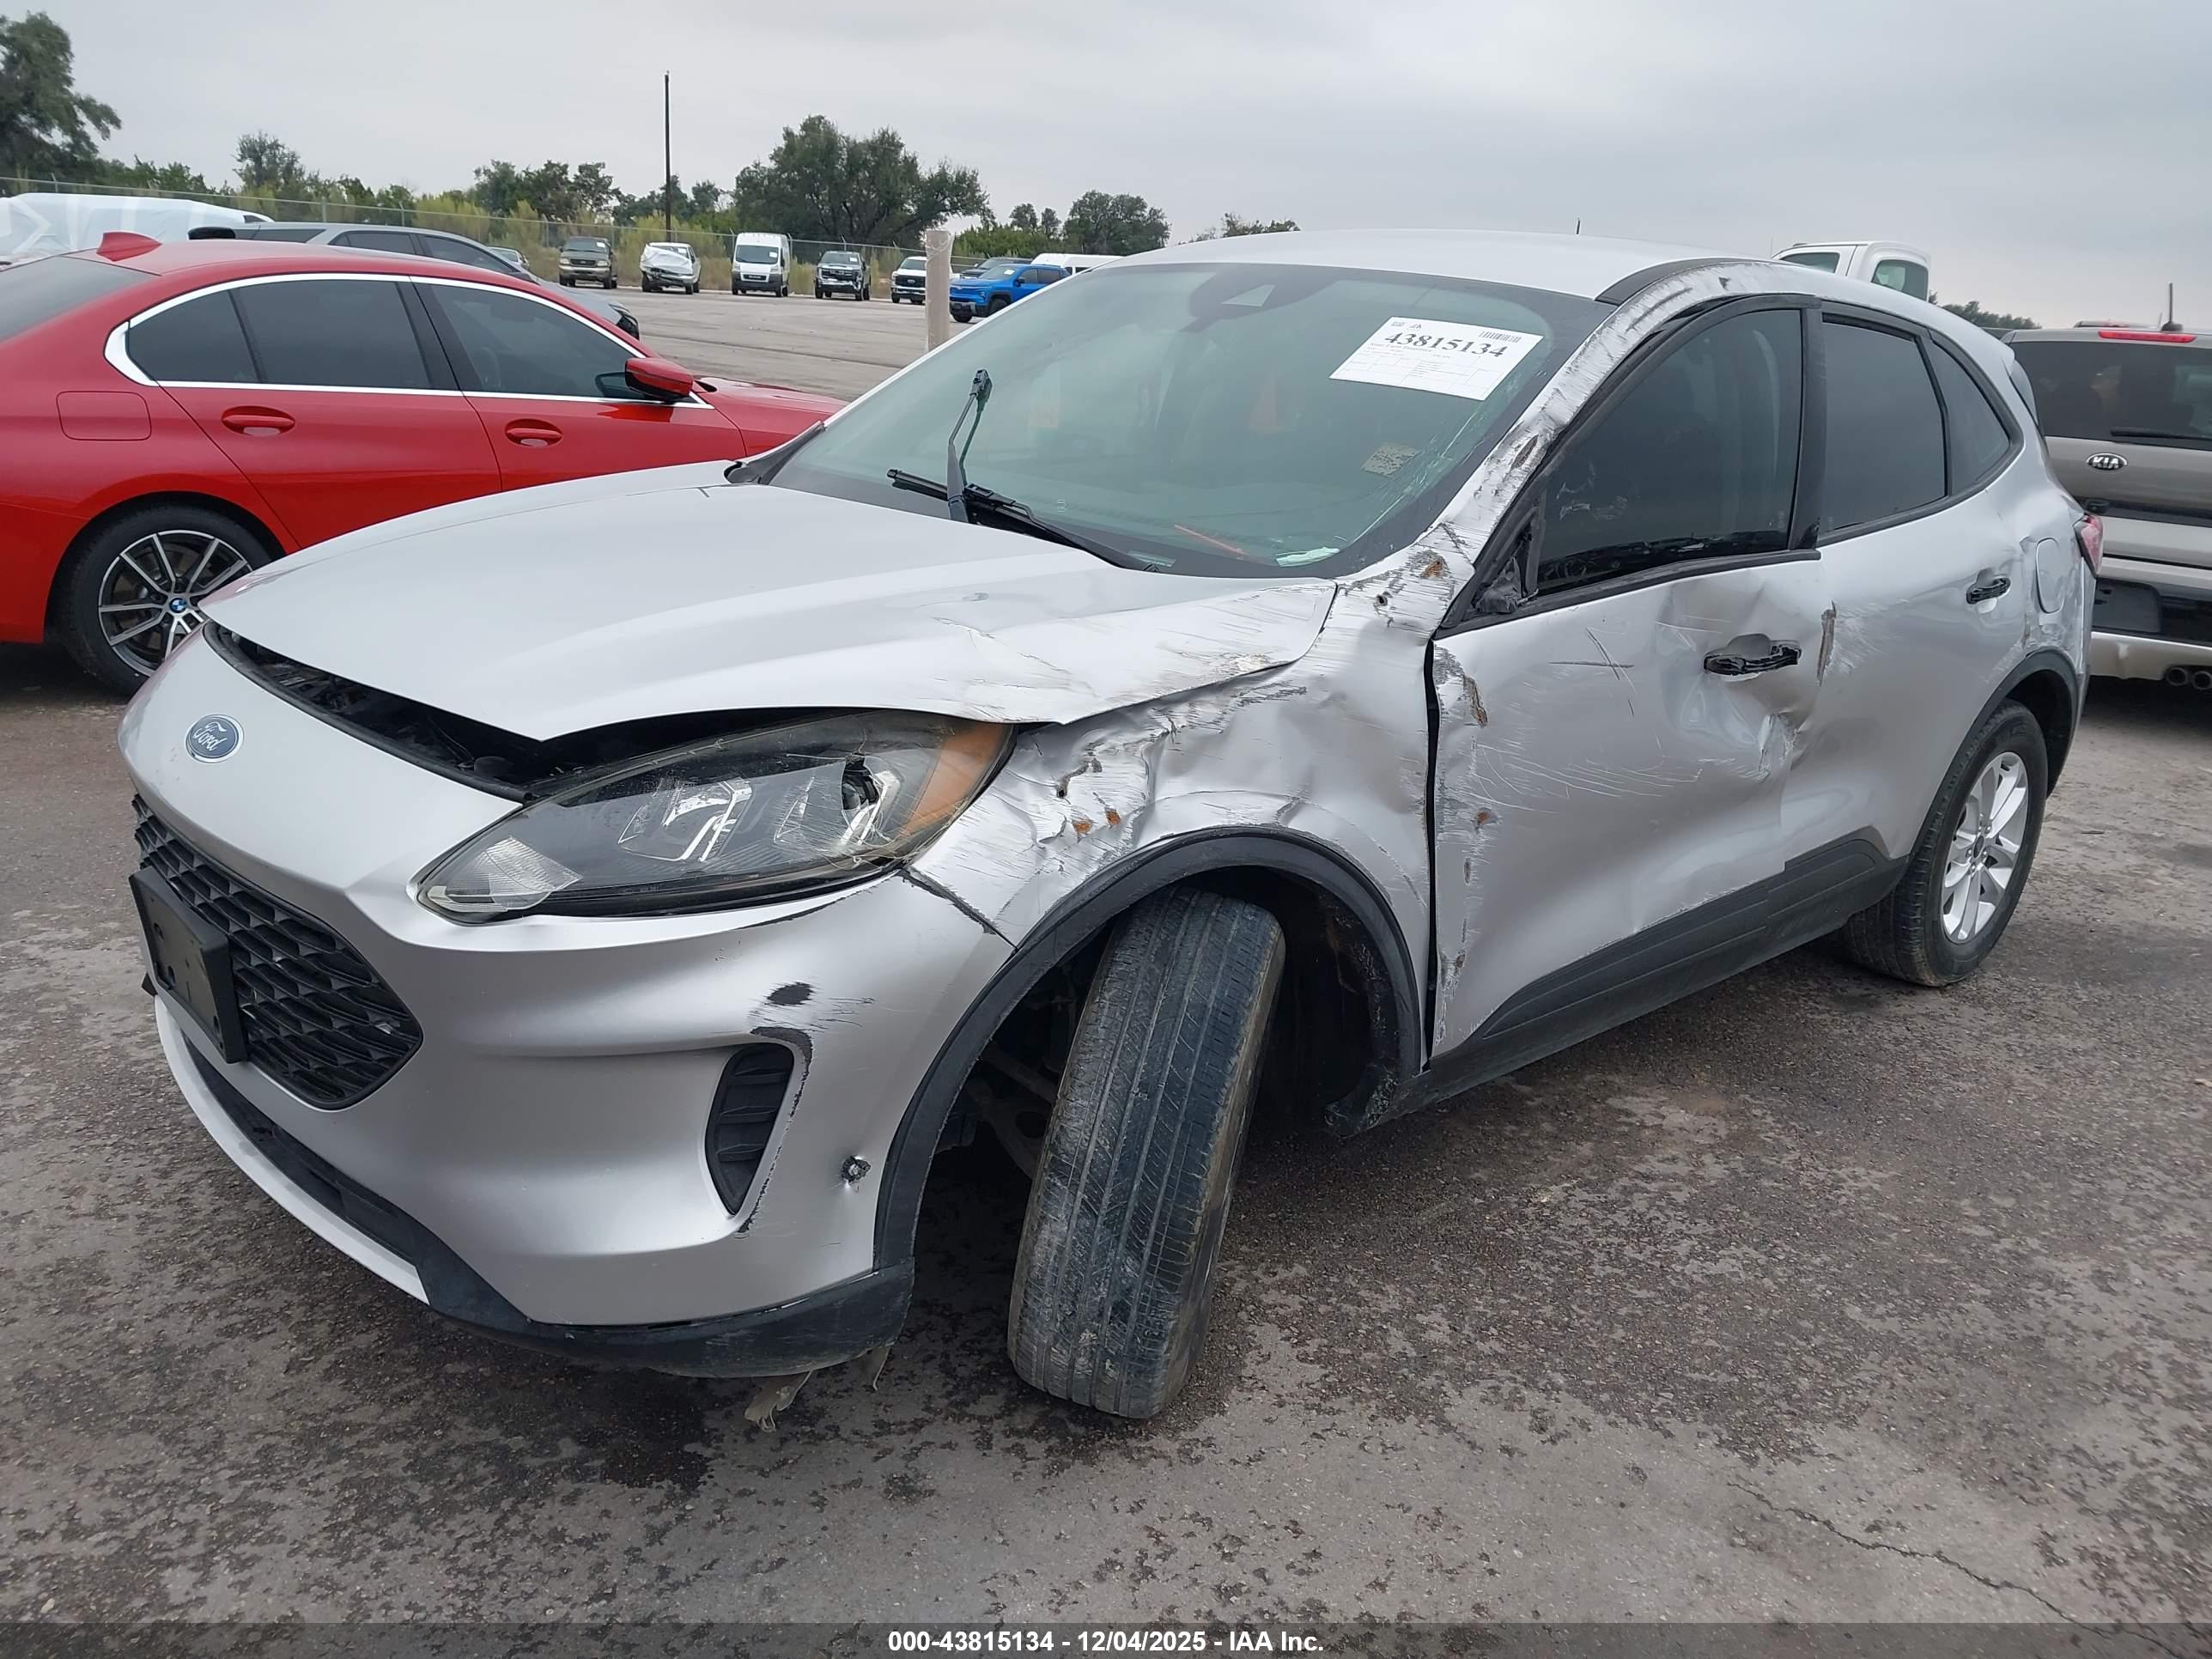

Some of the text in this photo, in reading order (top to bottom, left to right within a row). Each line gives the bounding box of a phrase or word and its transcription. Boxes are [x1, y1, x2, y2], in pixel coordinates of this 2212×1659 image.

[1384, 331, 1508, 357] 43815134
[2092, 456, 2119, 470] KIA
[191, 720, 228, 751] Ford
